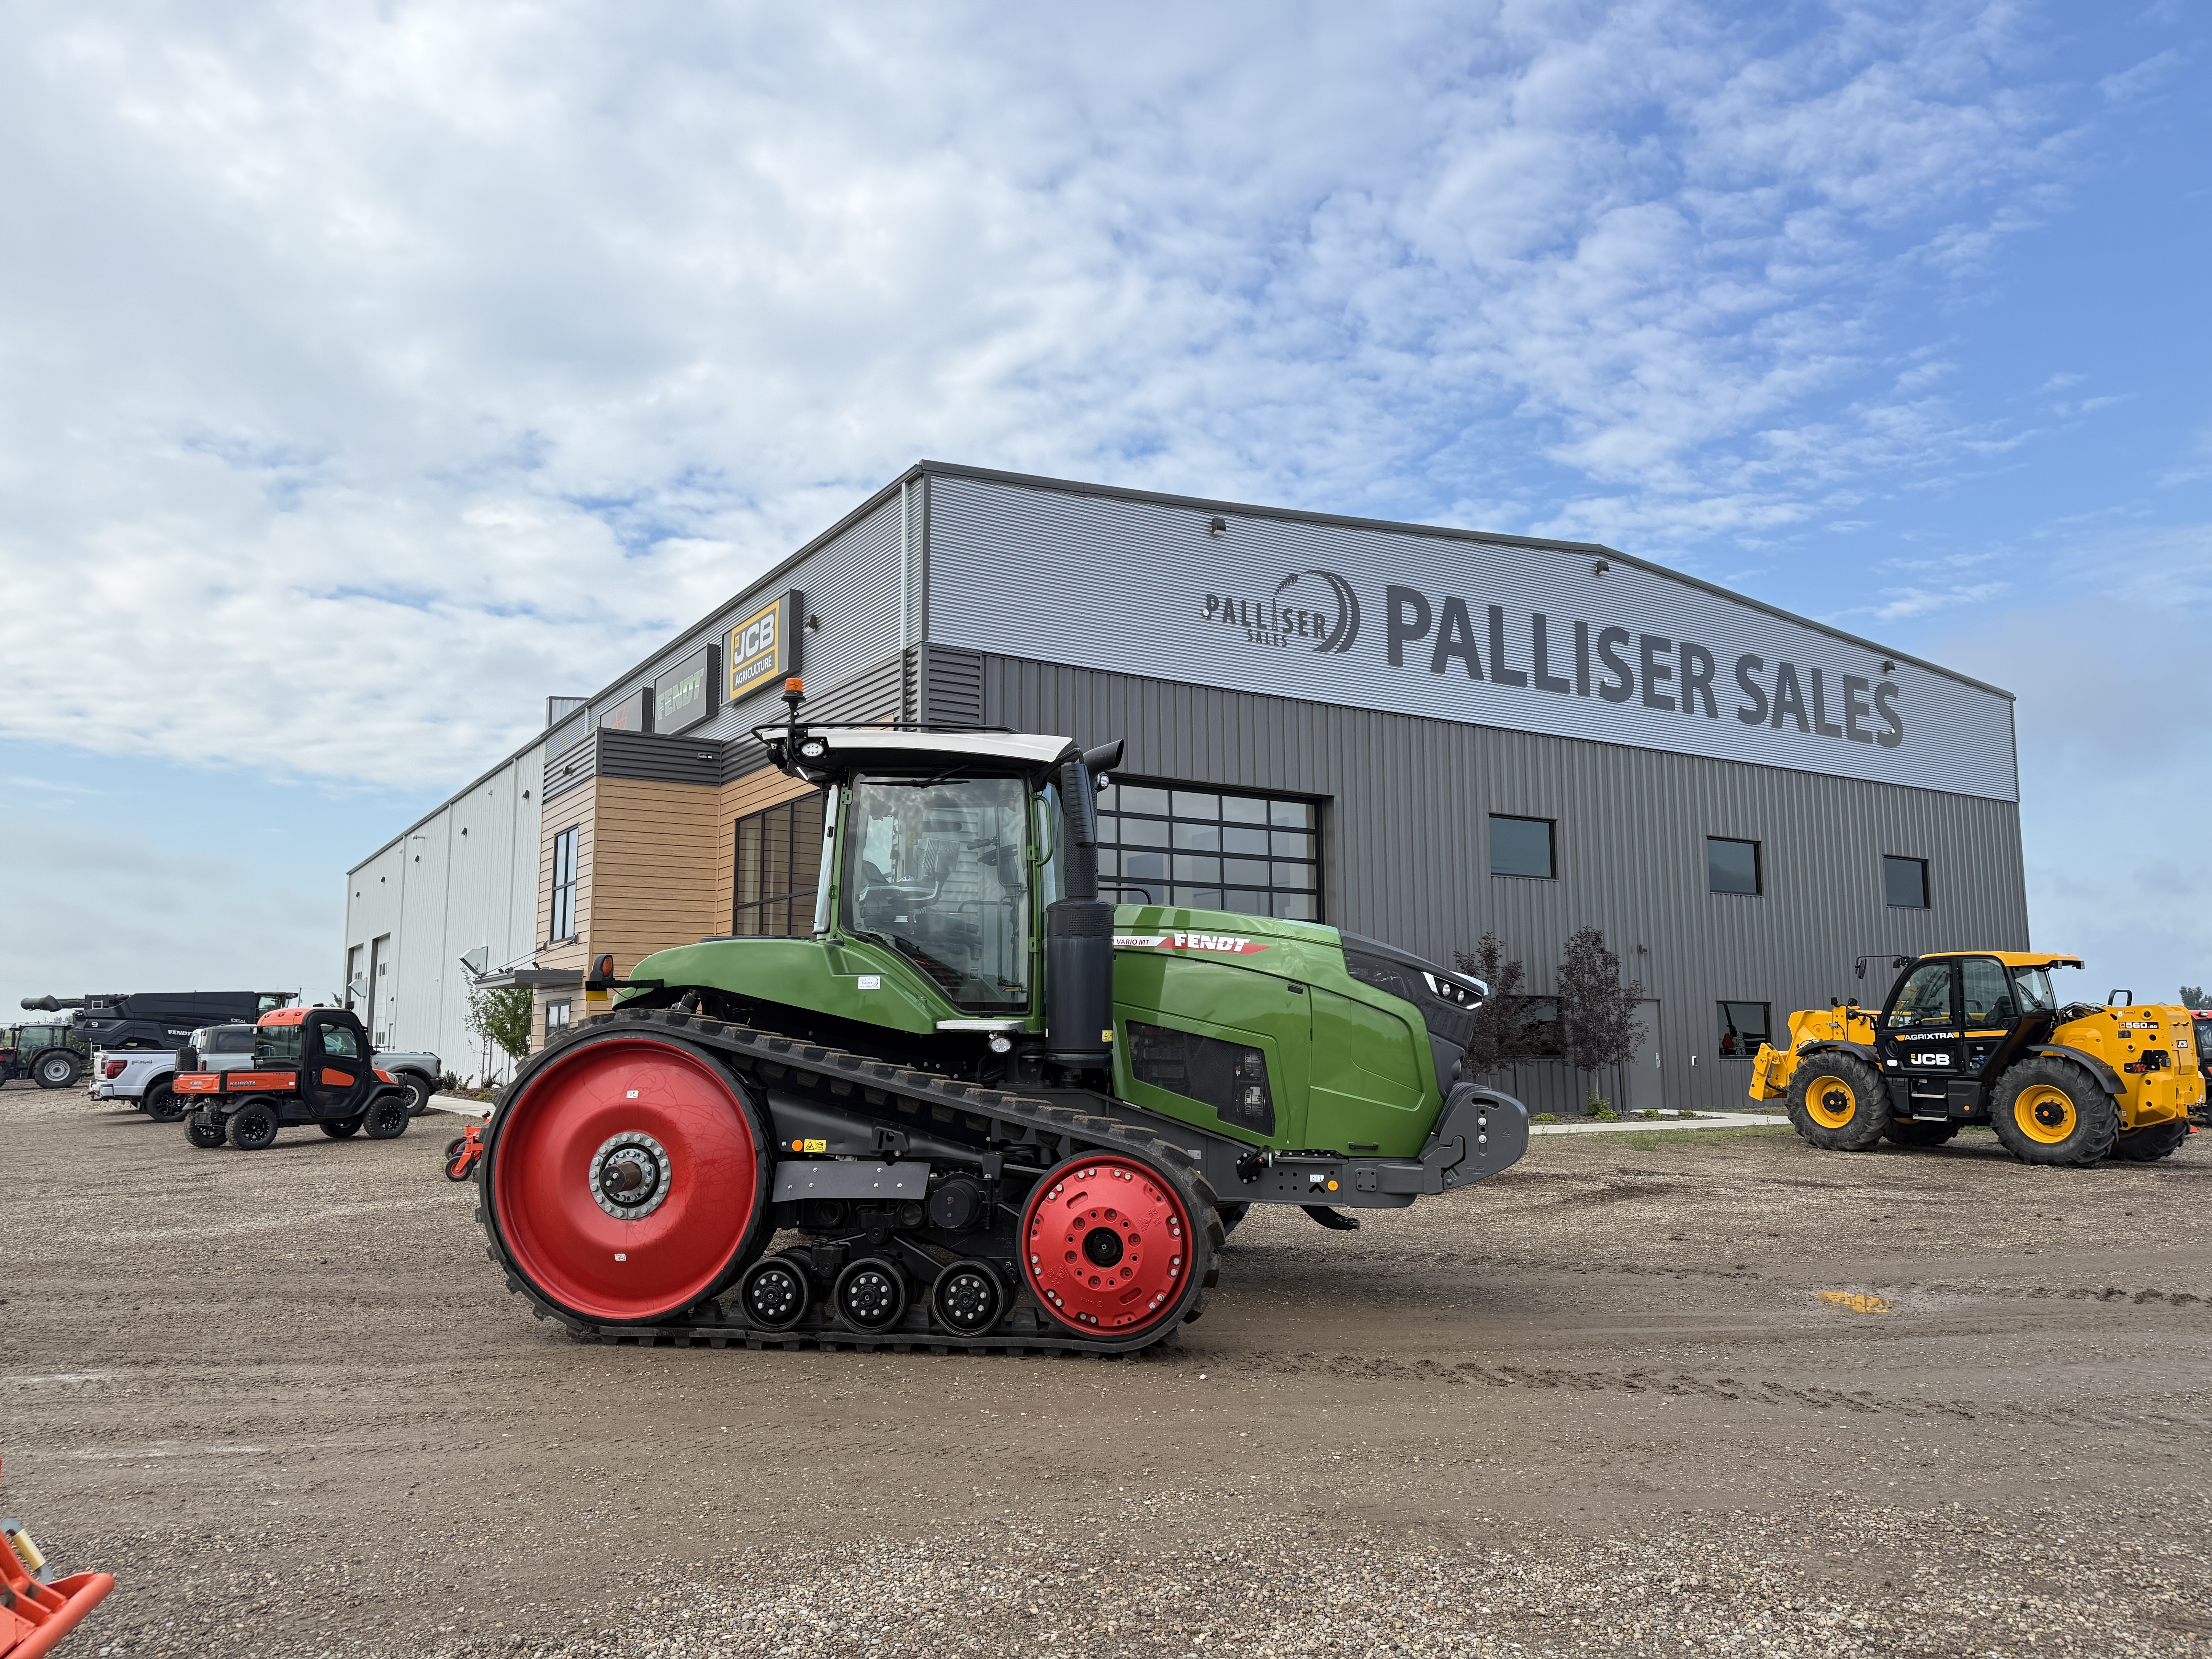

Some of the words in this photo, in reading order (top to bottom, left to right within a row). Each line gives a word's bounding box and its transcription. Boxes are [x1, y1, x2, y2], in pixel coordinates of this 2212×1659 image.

[734, 614, 774, 664] JCB
[1248, 630, 1288, 647] SALES
[735, 655, 772, 686] AGRICULTURE
[1386, 585, 1719, 719] PALLISER
[1736, 654, 1903, 748] SALES
[657, 668, 704, 721] FENDT
[1174, 933, 1250, 952] FENDT
[1905, 1032, 1955, 1041] AGRIXTRA
[1911, 1053, 1950, 1065] JCB
